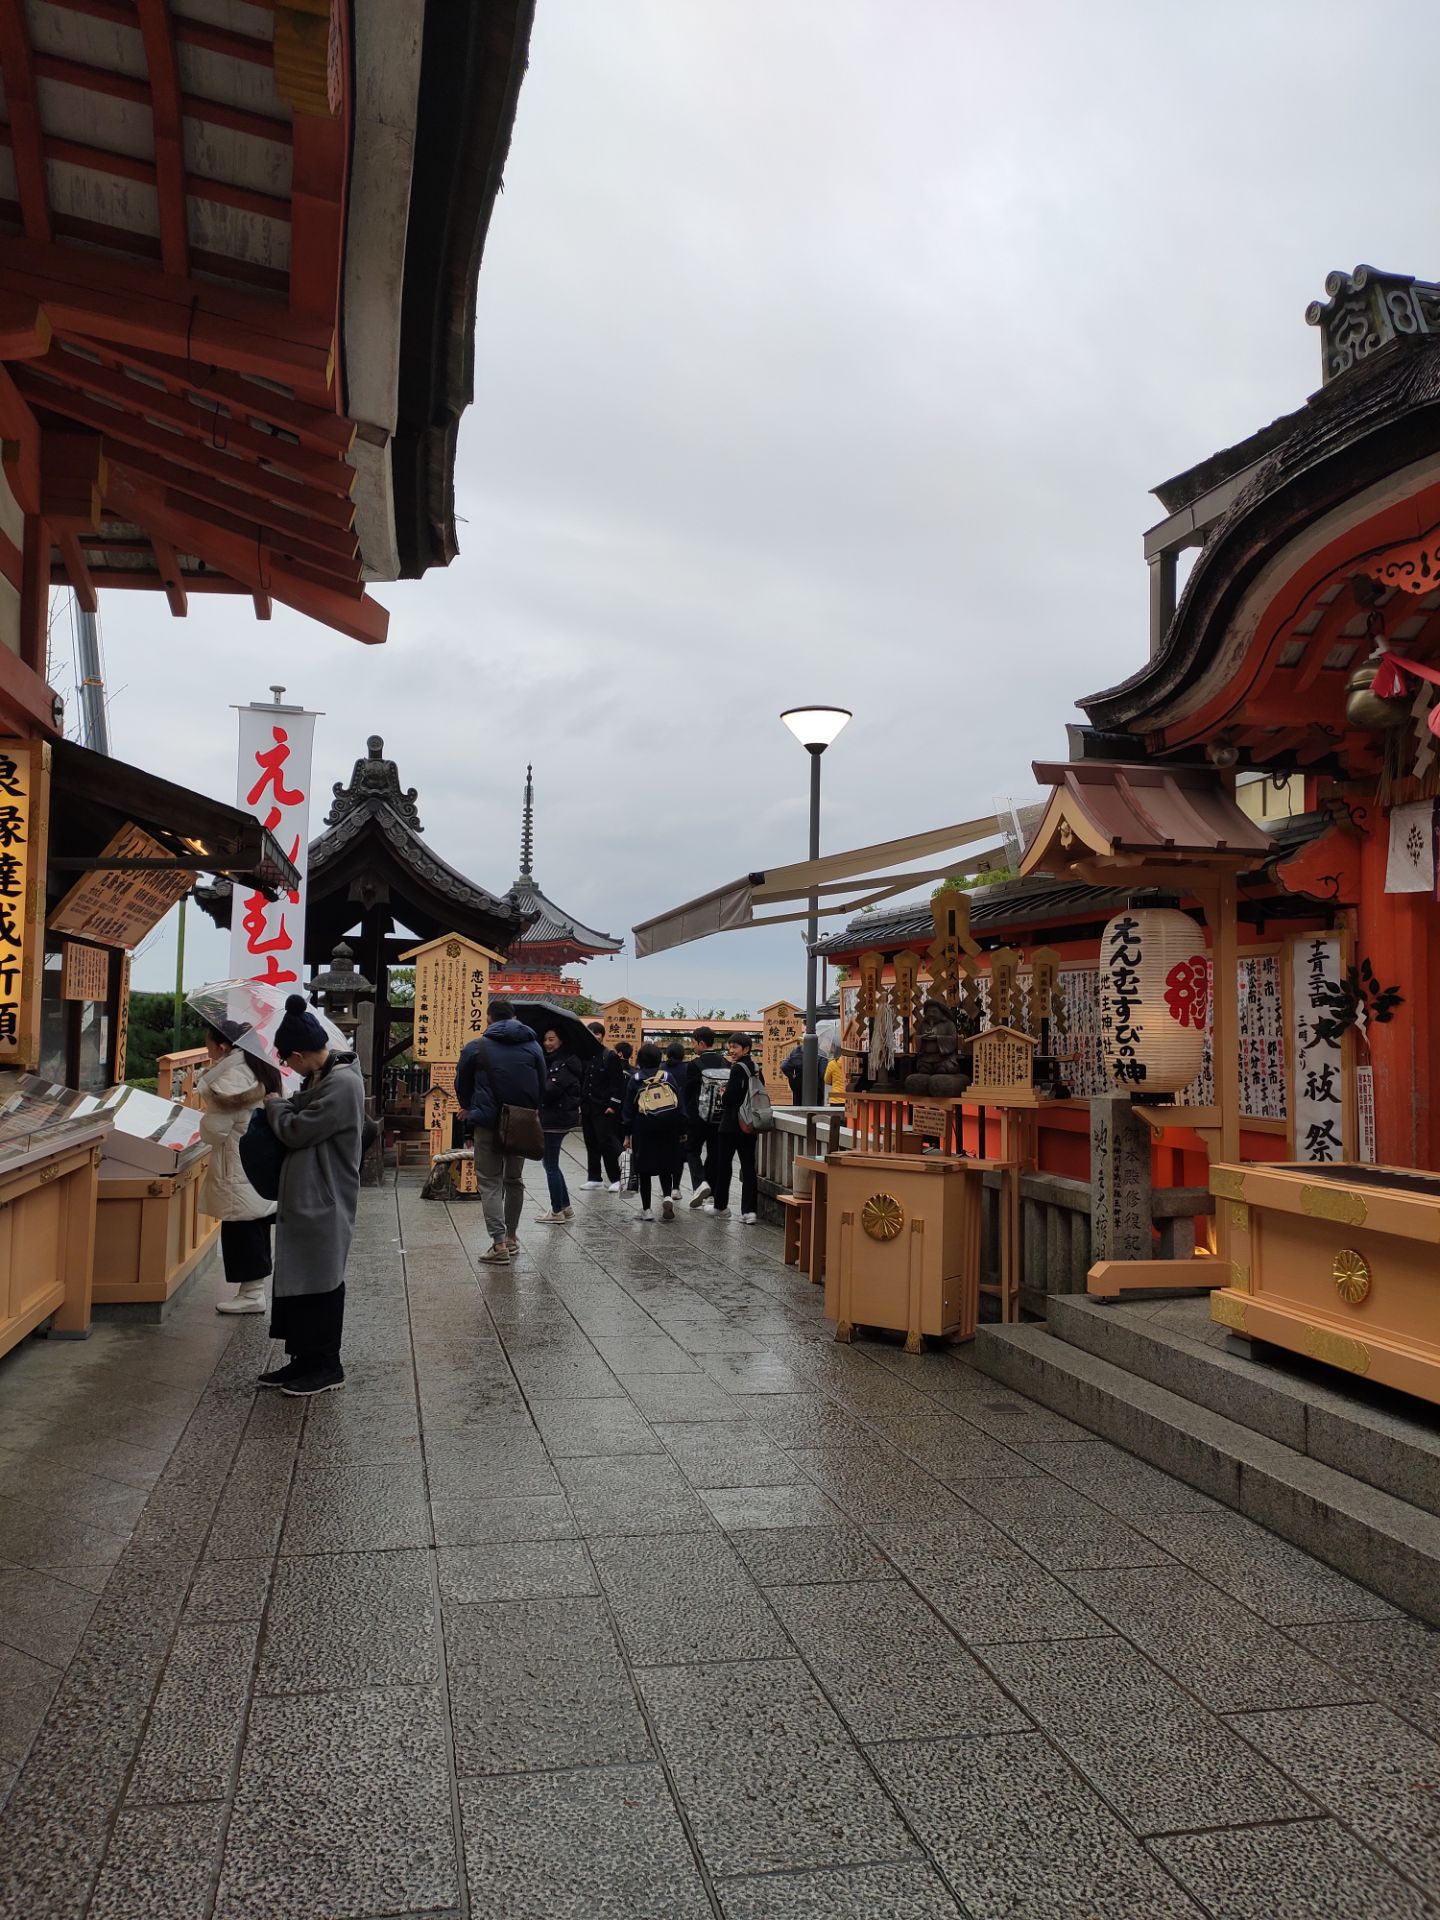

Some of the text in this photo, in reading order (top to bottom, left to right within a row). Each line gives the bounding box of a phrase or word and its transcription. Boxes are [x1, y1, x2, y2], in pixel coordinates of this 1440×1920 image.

[1246, 959, 1257, 1004] 浜松市
[1263, 957, 1274, 997] 堺市
[470, 969, 485, 1032] 恋占いの石
[1101, 973, 1115, 1056] 地主神社
[1110, 917, 1147, 1085] えんむすびの神
[418, 1014, 429, 1057] 地主神社
[608, 1023, 636, 1034] 絵馬
[769, 1026, 796, 1038] 絵馬
[1298, 1014, 1308, 1071] 三時より
[1249, 1038, 1260, 1086] 大分市
[1267, 1040, 1278, 1086] 郡上市
